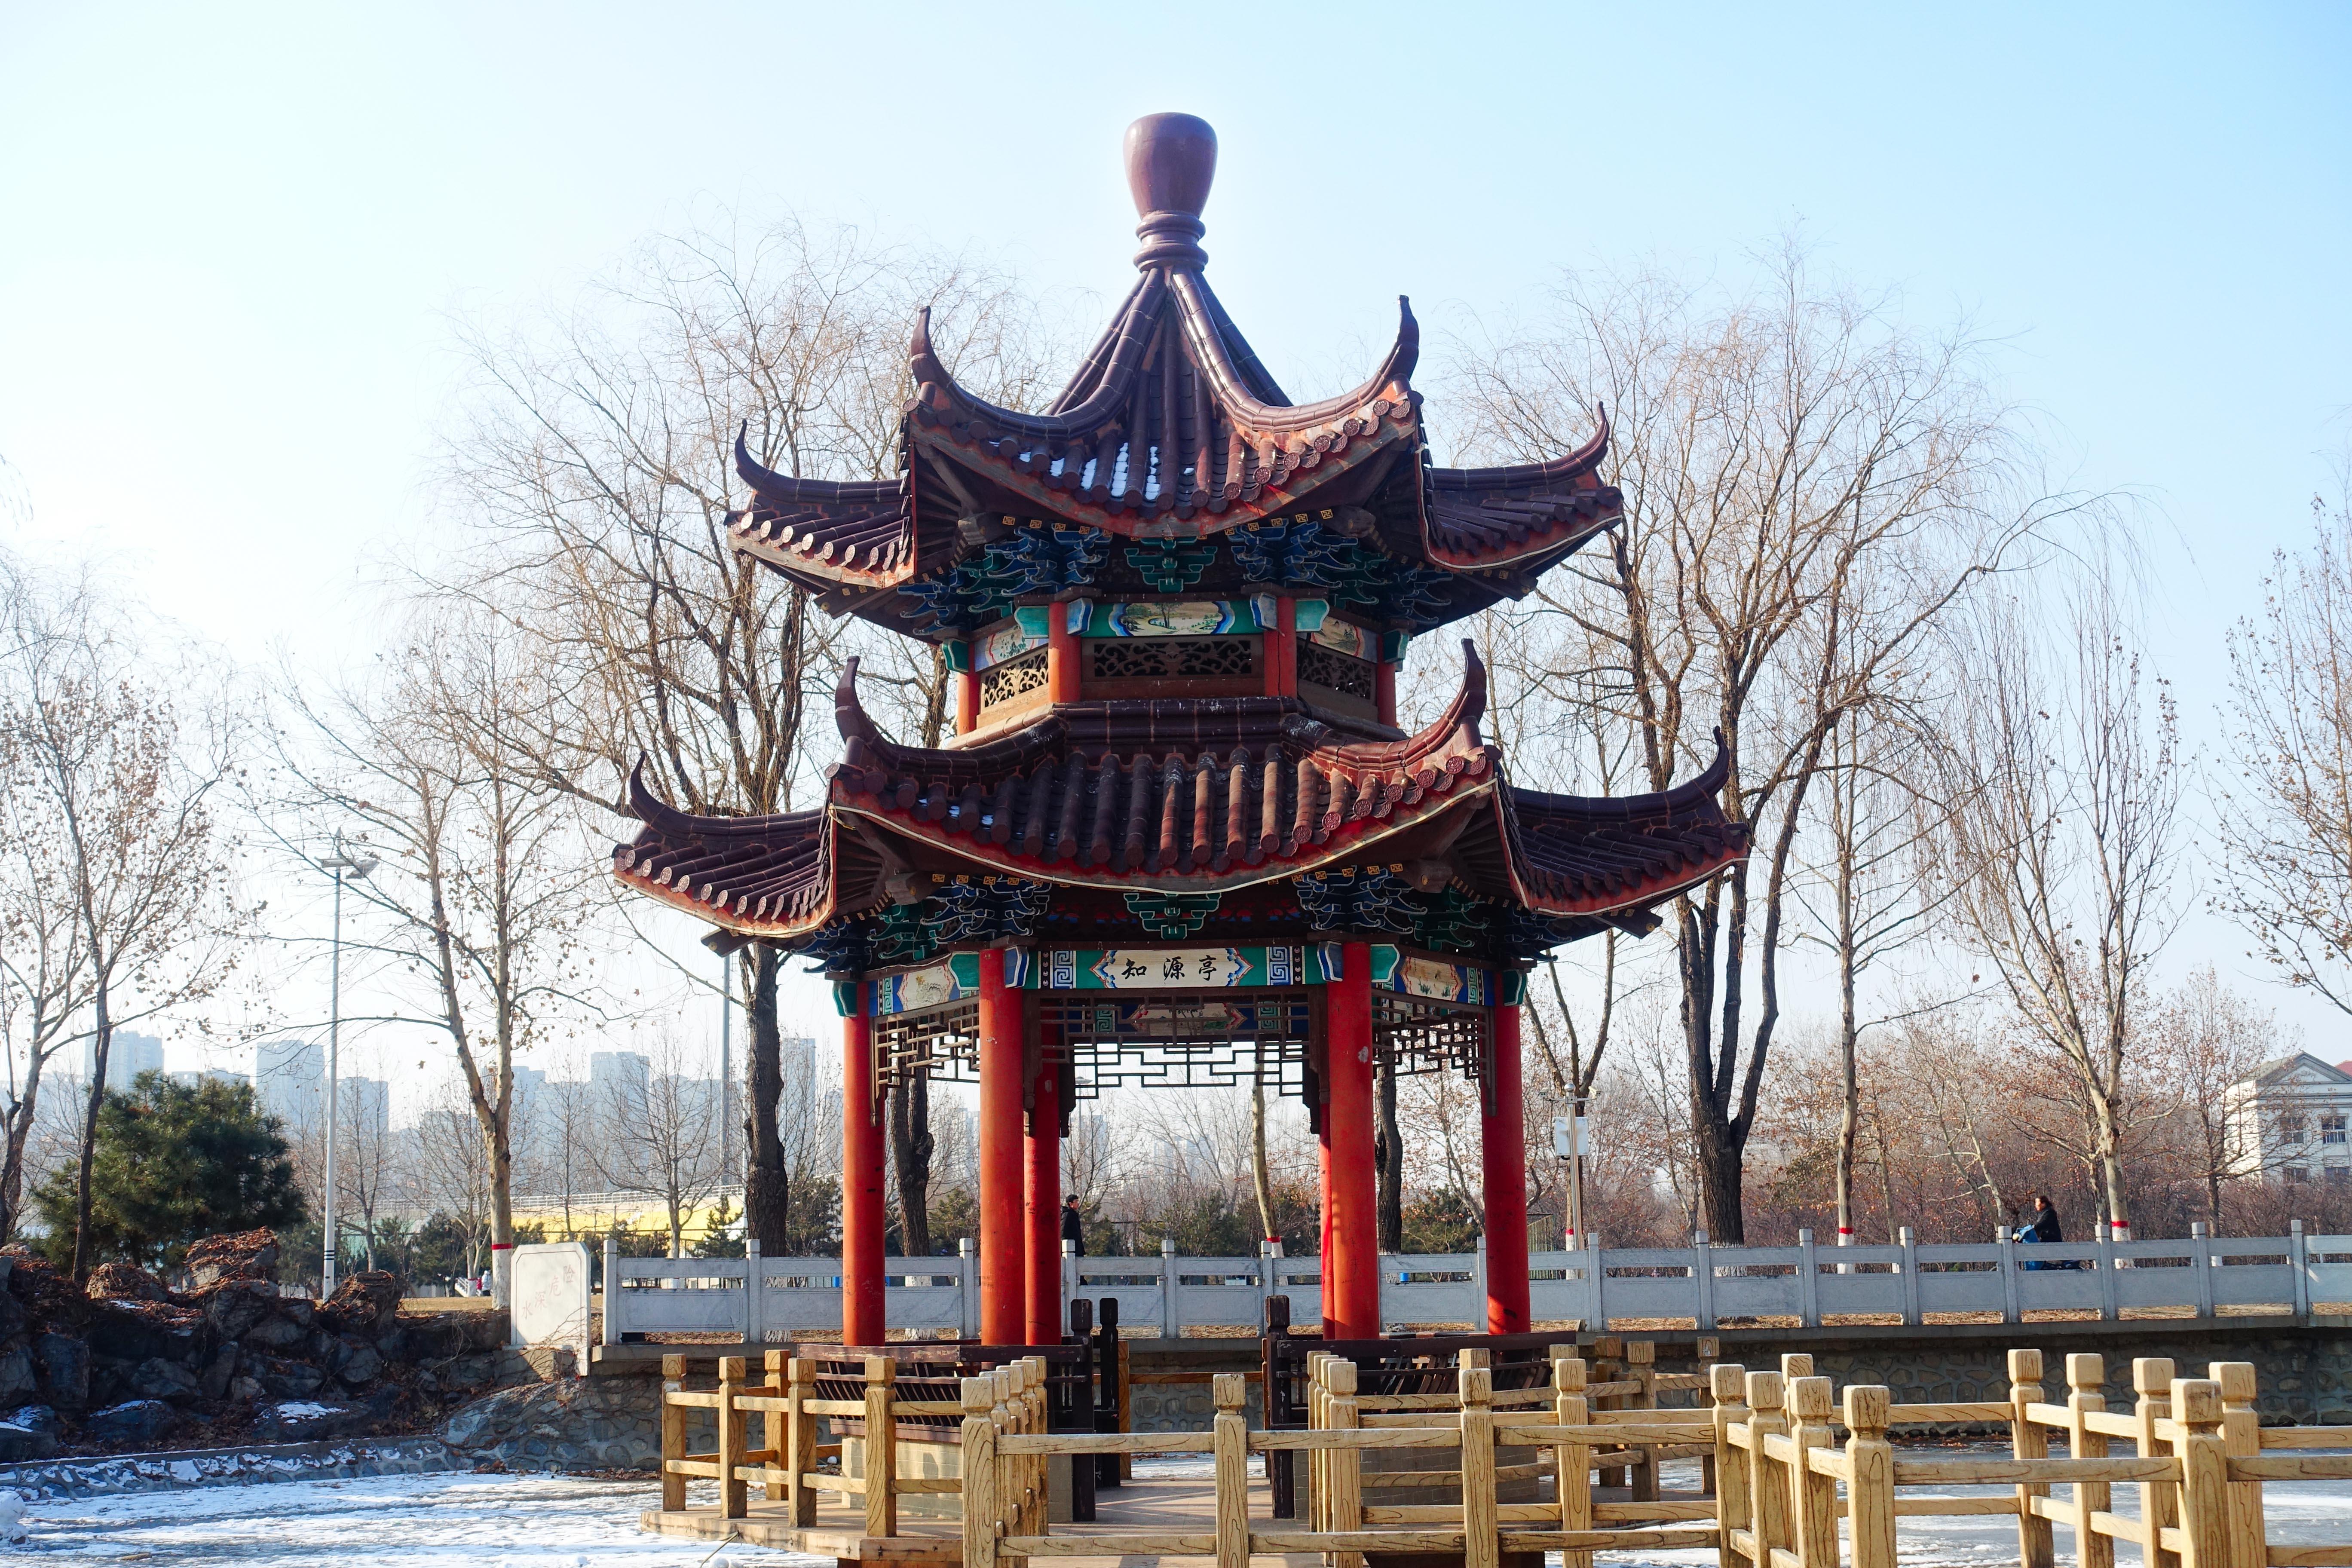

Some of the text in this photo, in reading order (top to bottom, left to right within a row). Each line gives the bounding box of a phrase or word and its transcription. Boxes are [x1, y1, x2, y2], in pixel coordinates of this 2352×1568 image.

[1121, 955, 1217, 981] 知源亭
[522, 1264, 575, 1319] 水深危险
